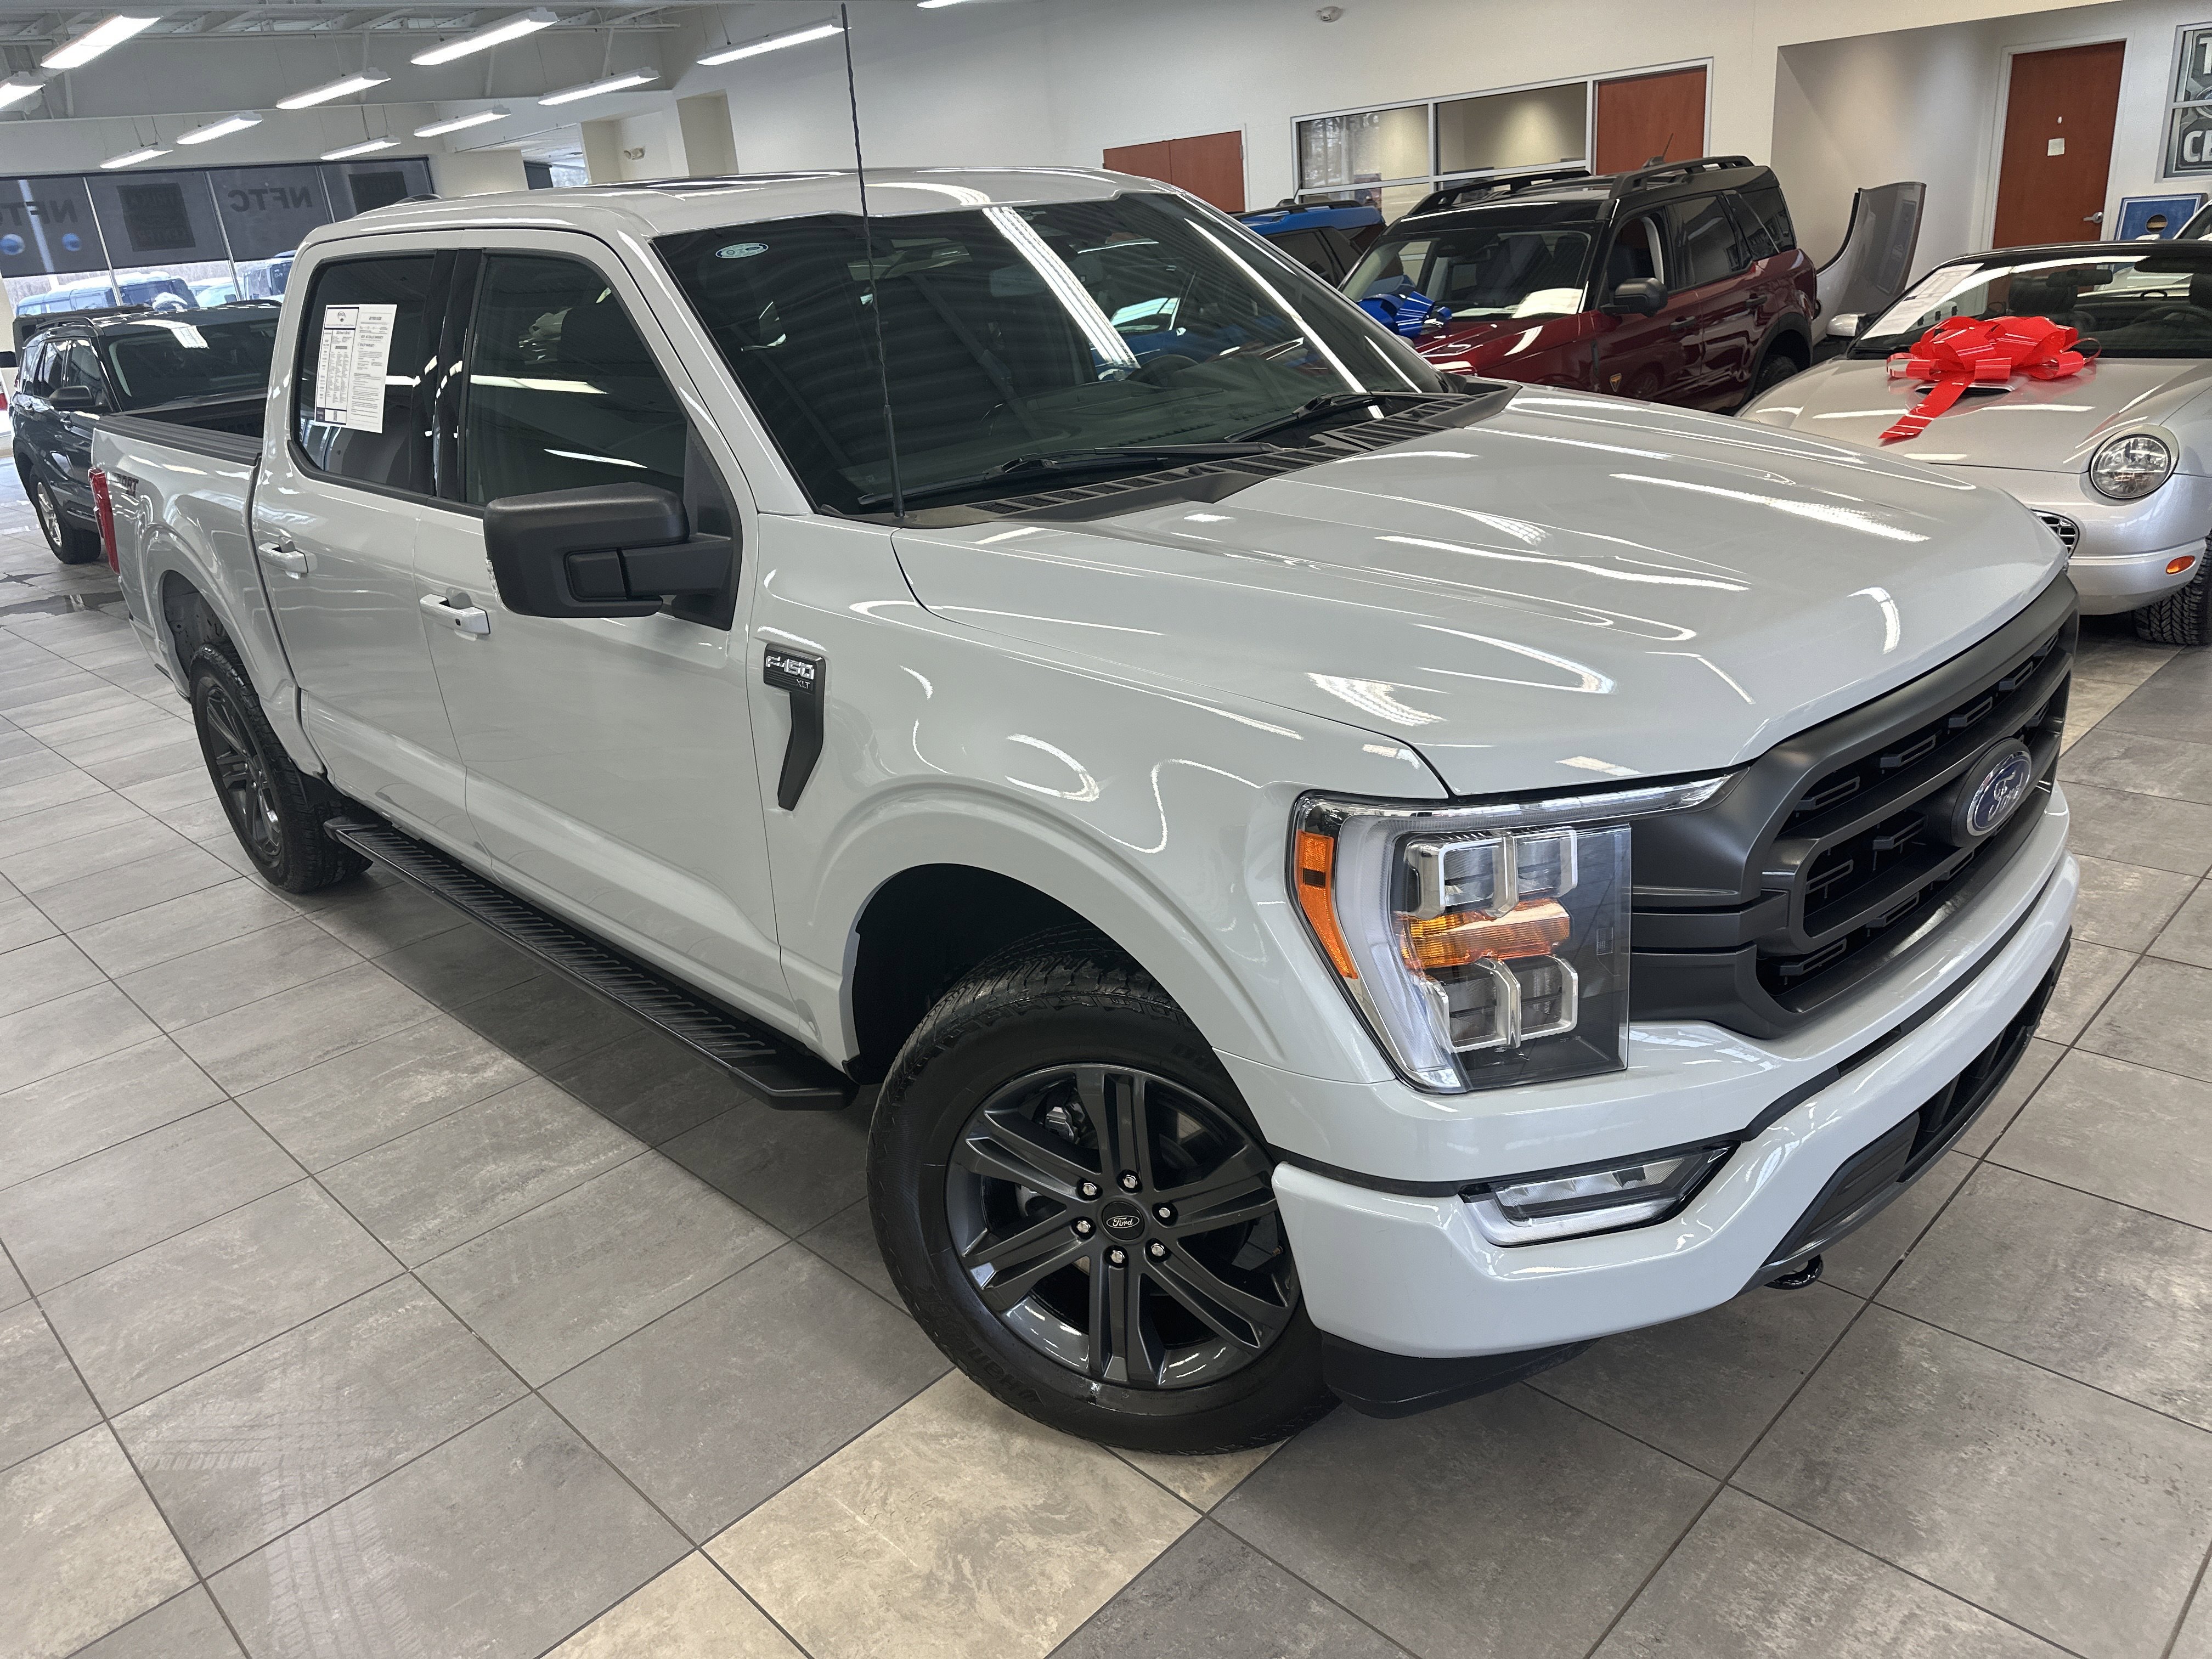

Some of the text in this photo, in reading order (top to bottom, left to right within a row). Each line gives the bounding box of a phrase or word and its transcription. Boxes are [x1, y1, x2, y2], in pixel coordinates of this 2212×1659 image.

[765, 655, 815, 680] F-150
[796, 679, 810, 690] XLT
[1988, 769, 2024, 821] Ford
[1112, 1217, 1134, 1227] Ford
